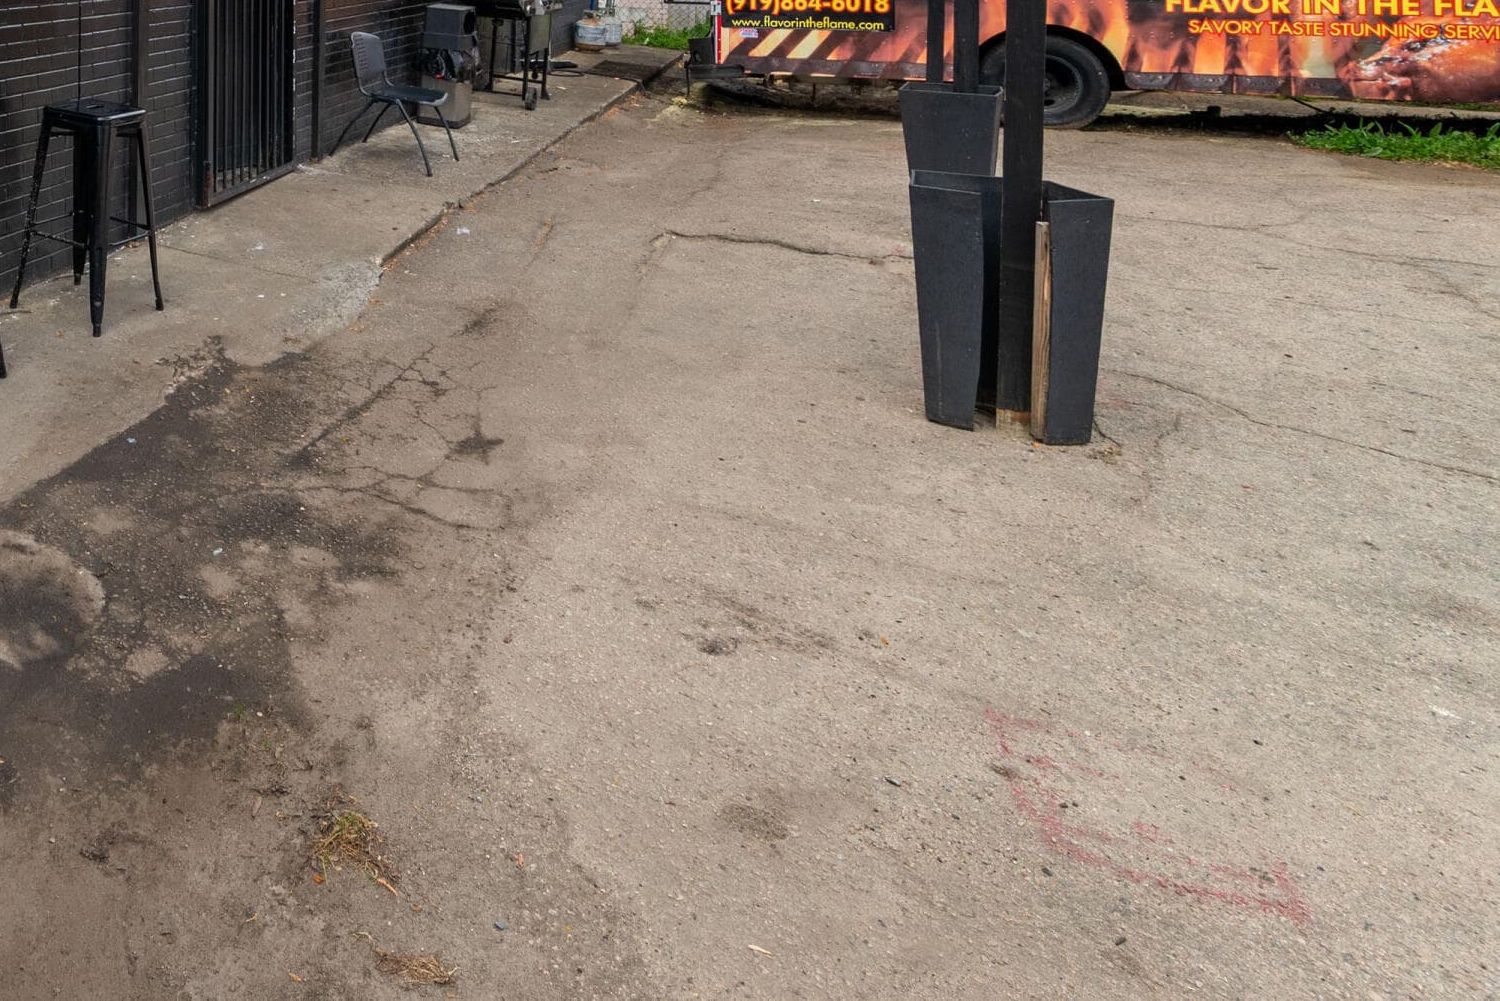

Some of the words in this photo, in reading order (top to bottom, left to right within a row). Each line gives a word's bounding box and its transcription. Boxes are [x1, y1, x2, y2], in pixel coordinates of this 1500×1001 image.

[731, 15, 885, 31] www.flavorintheflame.com
[1187, 18, 1264, 36] SAVORY
[1269, 20, 1325, 37] TASTE
[1329, 21, 1439, 40] STUNNING
